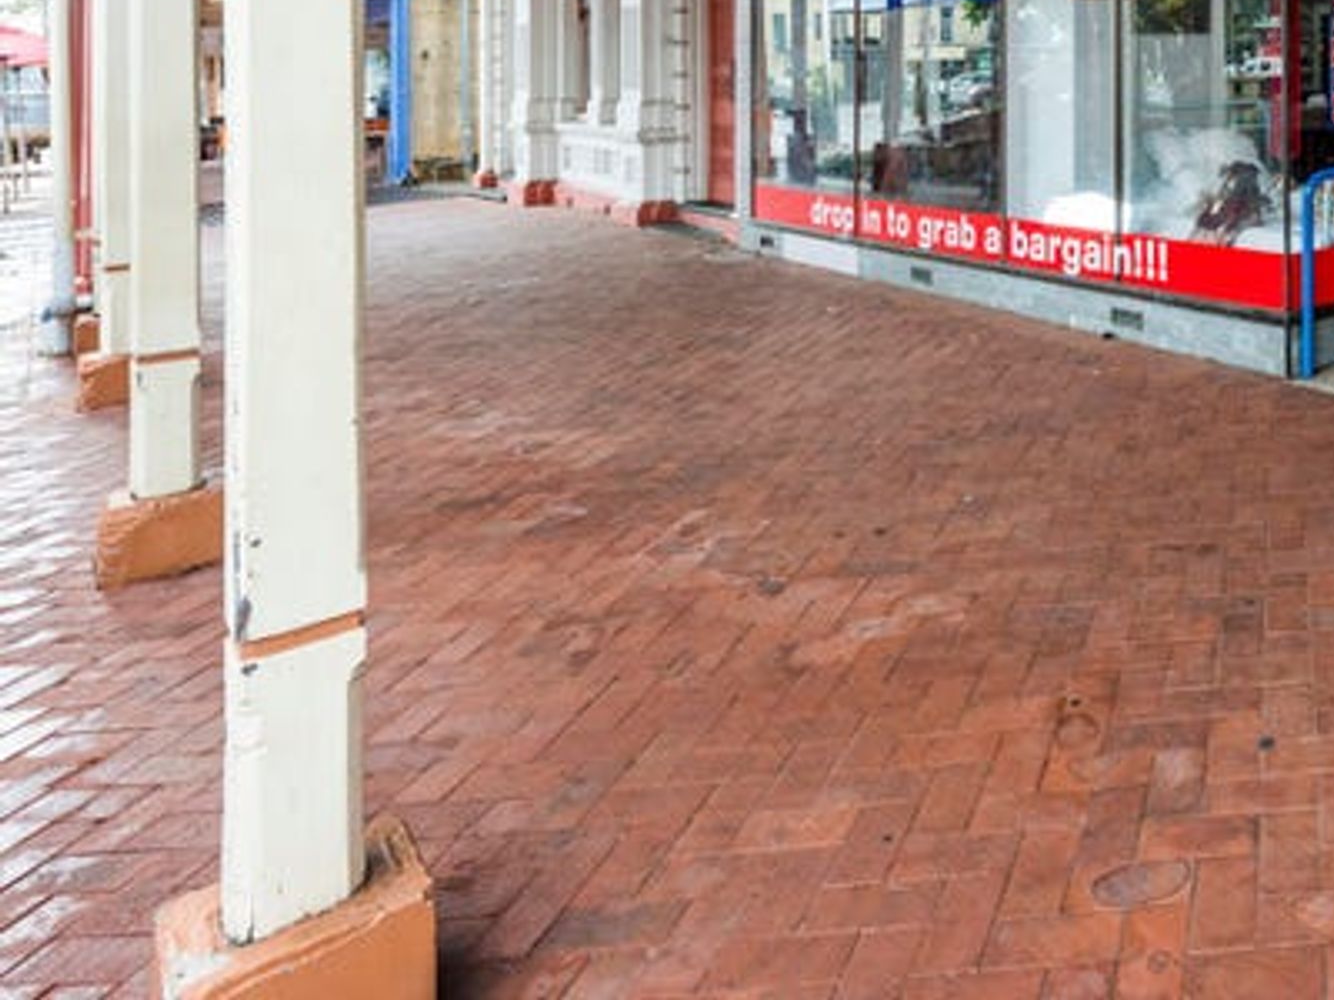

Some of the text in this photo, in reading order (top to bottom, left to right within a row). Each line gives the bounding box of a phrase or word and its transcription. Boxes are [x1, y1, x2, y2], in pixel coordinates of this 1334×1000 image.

[809, 197, 1169, 282] drop in to grab a bargain!!!
